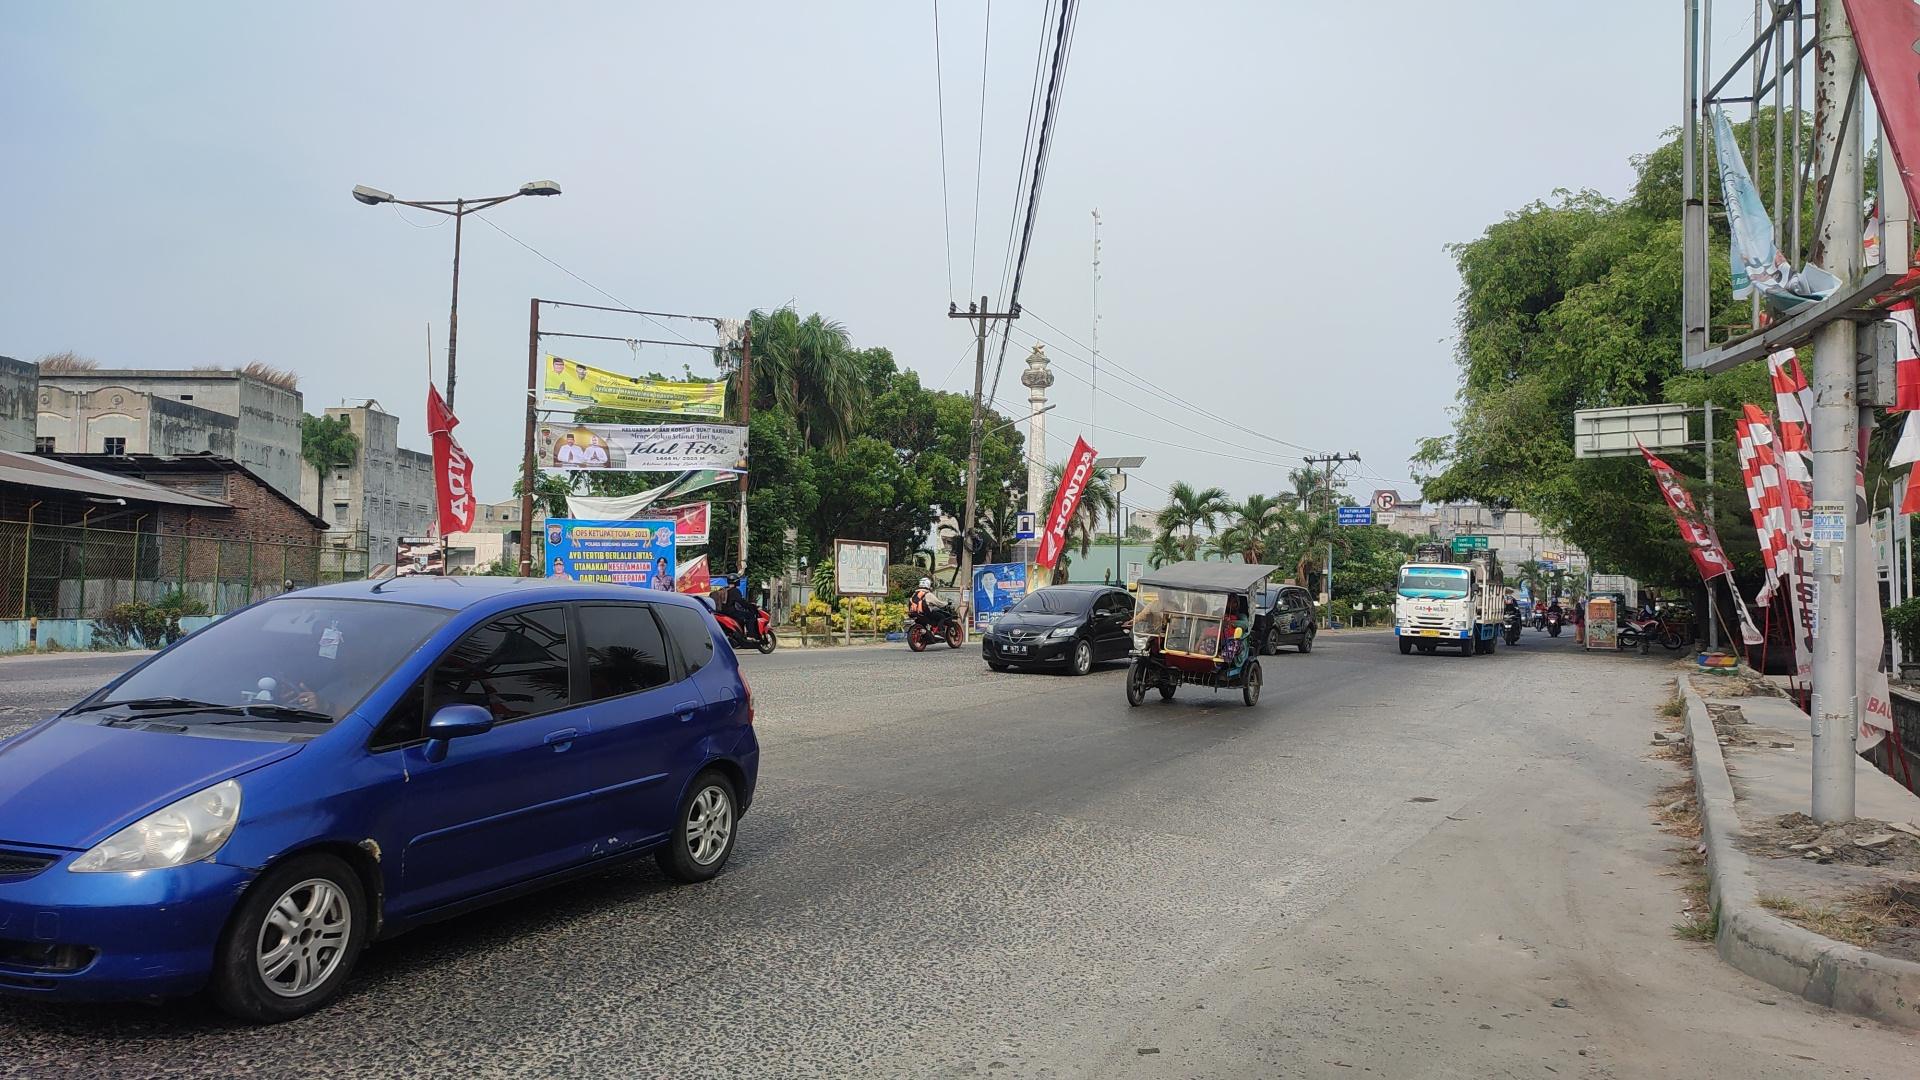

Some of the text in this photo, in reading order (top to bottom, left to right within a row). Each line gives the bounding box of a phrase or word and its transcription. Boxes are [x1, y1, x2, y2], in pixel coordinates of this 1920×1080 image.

[630, 441, 731, 455] Idul Fitri
[1054, 452, 1093, 538] HONDA
[1833, 515, 1844, 525] WC
[588, 530, 614, 538] KETUPAT
[634, 530, 648, 538] 2023
[569, 551, 582, 560] AYO
[583, 551, 605, 560] TERTIB
[605, 551, 632, 560] BERLALU
[574, 562, 651, 571] UTAMAKAN KESELAMATAN
[580, 574, 595, 582] DARI
[596, 574, 612, 582] PADA
